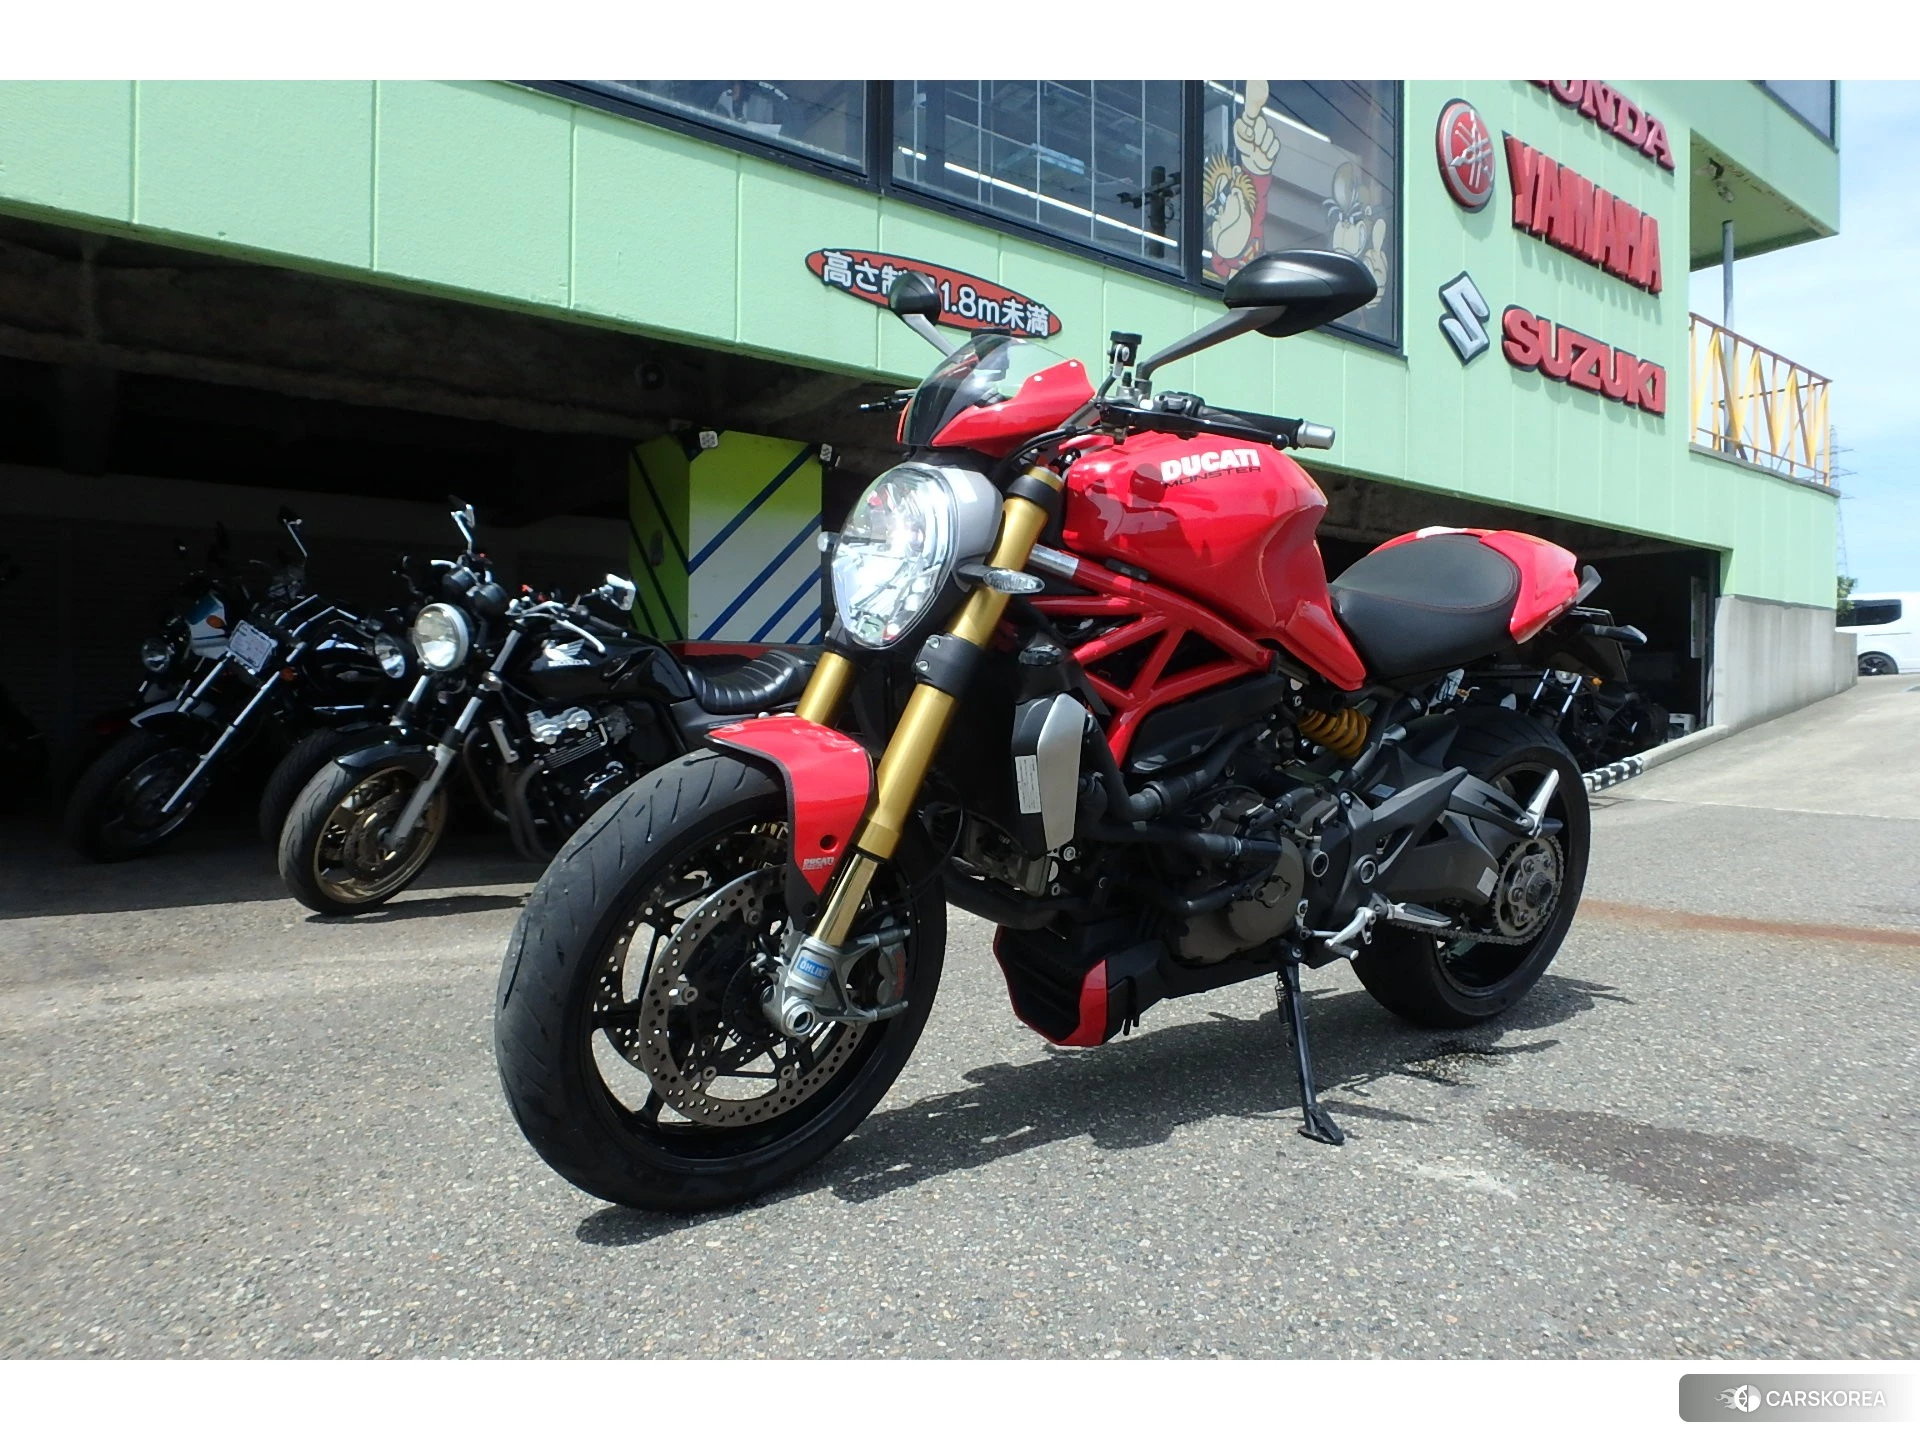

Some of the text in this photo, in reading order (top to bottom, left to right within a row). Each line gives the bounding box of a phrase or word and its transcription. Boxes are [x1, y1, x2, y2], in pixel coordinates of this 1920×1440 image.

[1526, 80, 1675, 172] ONDA
[1503, 131, 1662, 295] YAMAHA
[1502, 306, 1666, 416] SUZUKI
[1161, 448, 1261, 482] DUCATI
[1163, 466, 1261, 488] MONSTER
